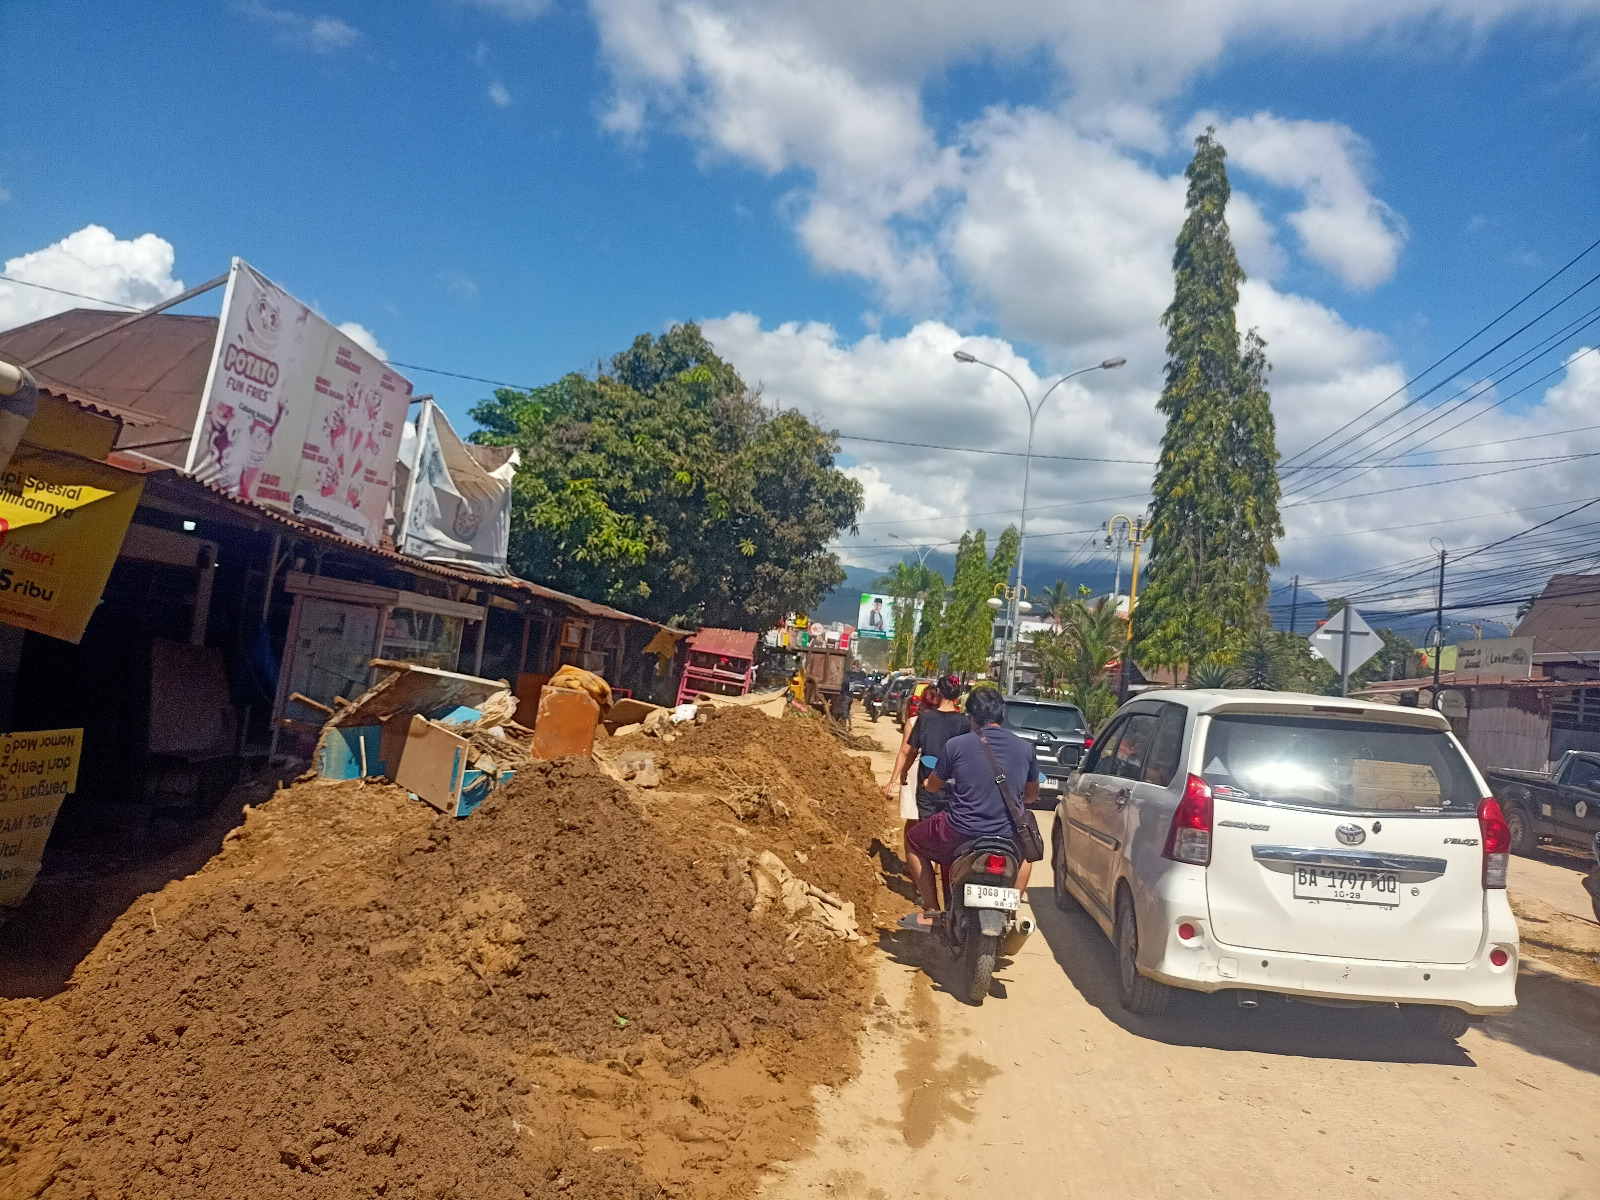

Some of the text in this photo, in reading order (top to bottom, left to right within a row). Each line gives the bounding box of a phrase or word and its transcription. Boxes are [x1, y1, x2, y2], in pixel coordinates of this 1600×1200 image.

[224, 343, 279, 388] POTATO
[226, 377, 269, 403] FUN FRIES
[24, 475, 82, 501] Spesial
[14, 579, 54, 601] ribu
[39, 735, 75, 748] Nomor
[1443, 837, 1479, 847] VELOZ
[966, 885, 972, 896] B
[1298, 867, 1317, 887] BA
[1327, 870, 1367, 891] 1797
